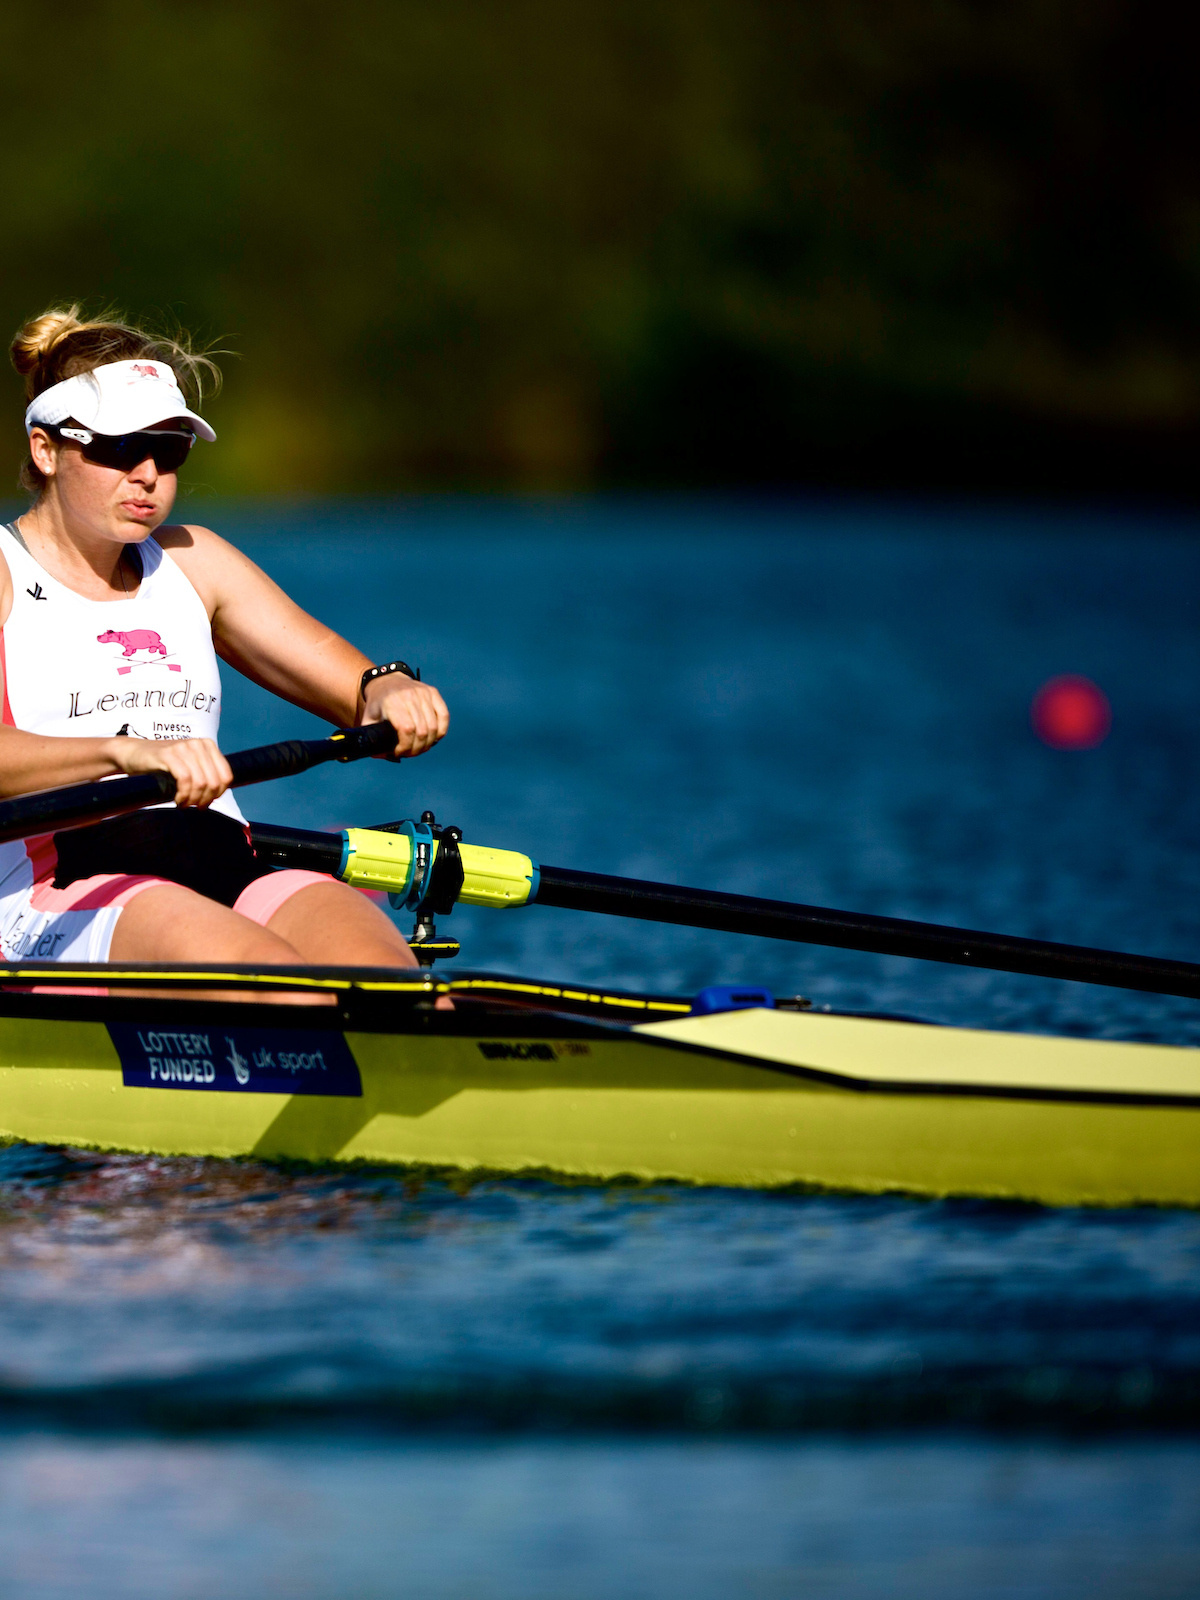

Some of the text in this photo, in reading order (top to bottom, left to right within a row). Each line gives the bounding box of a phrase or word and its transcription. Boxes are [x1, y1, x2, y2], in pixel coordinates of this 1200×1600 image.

[68, 679, 217, 719] Leander
[153, 722, 191, 733] Invesco
[137, 1031, 213, 1056] LOTTERY
[148, 1057, 215, 1083] FUNDED
[252, 1047, 327, 1075] uk sport
